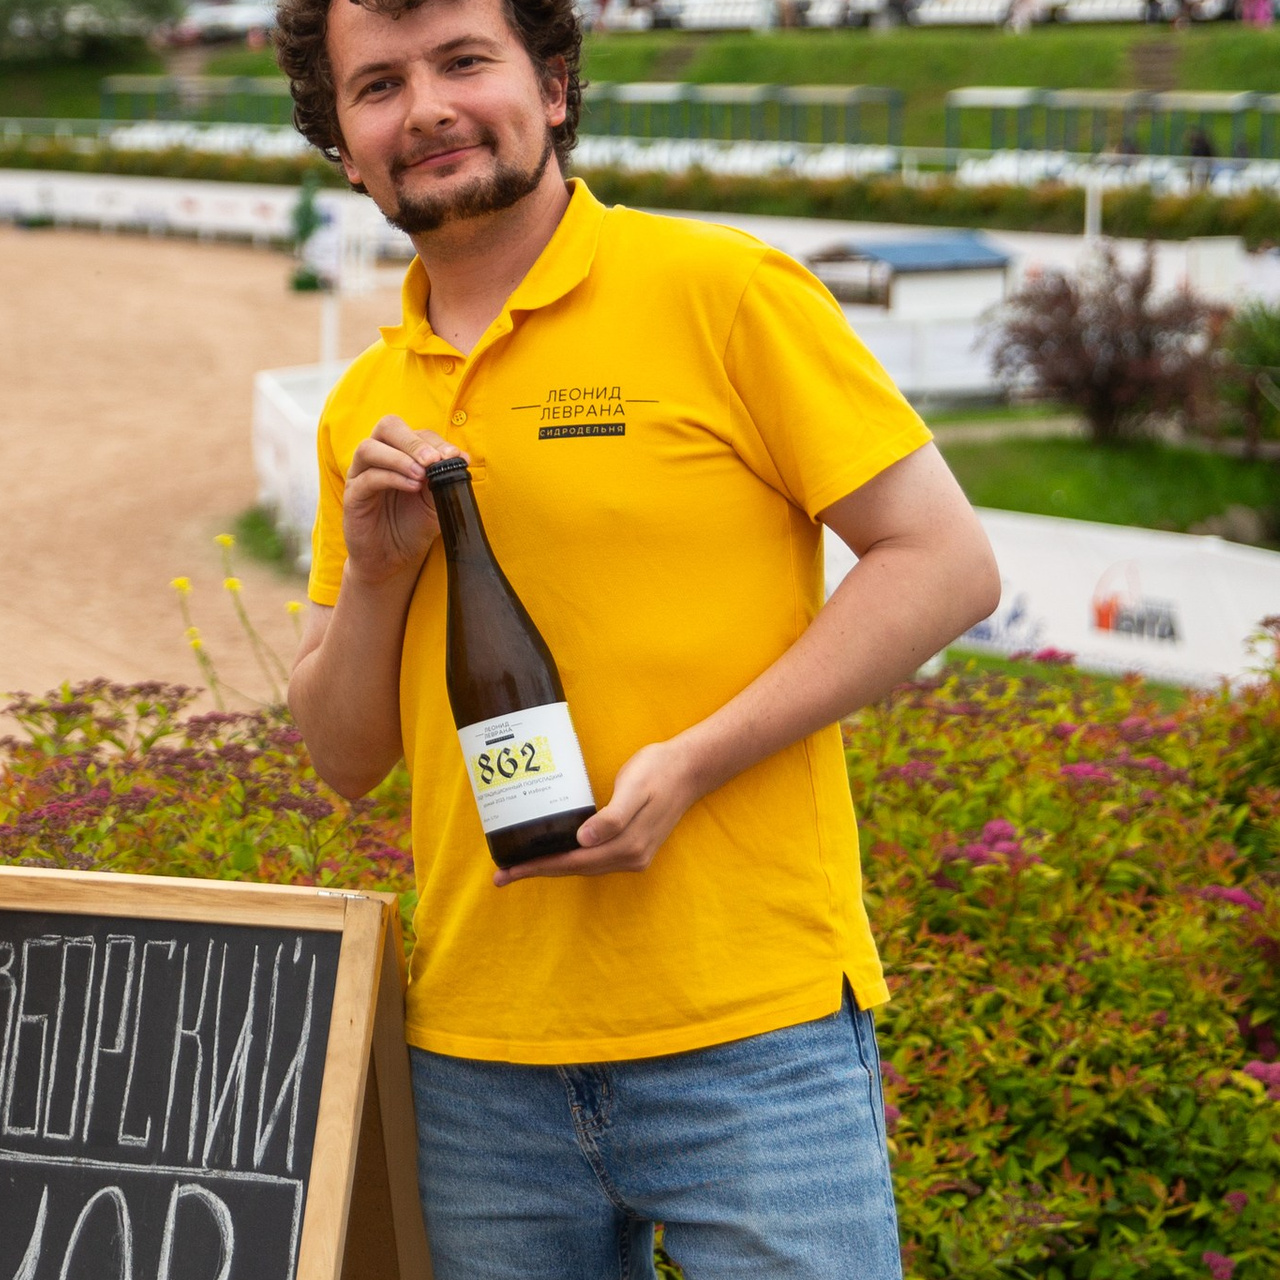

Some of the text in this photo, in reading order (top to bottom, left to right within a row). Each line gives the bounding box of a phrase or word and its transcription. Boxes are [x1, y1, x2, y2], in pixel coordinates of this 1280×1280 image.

[546, 386, 622, 403] ЛЕОНИД
[540, 403, 626, 421] ЛЕВРАНА
[539, 425, 624, 438] СИДРОДЕЛЬНЯ
[477, 742, 540, 784] 862
